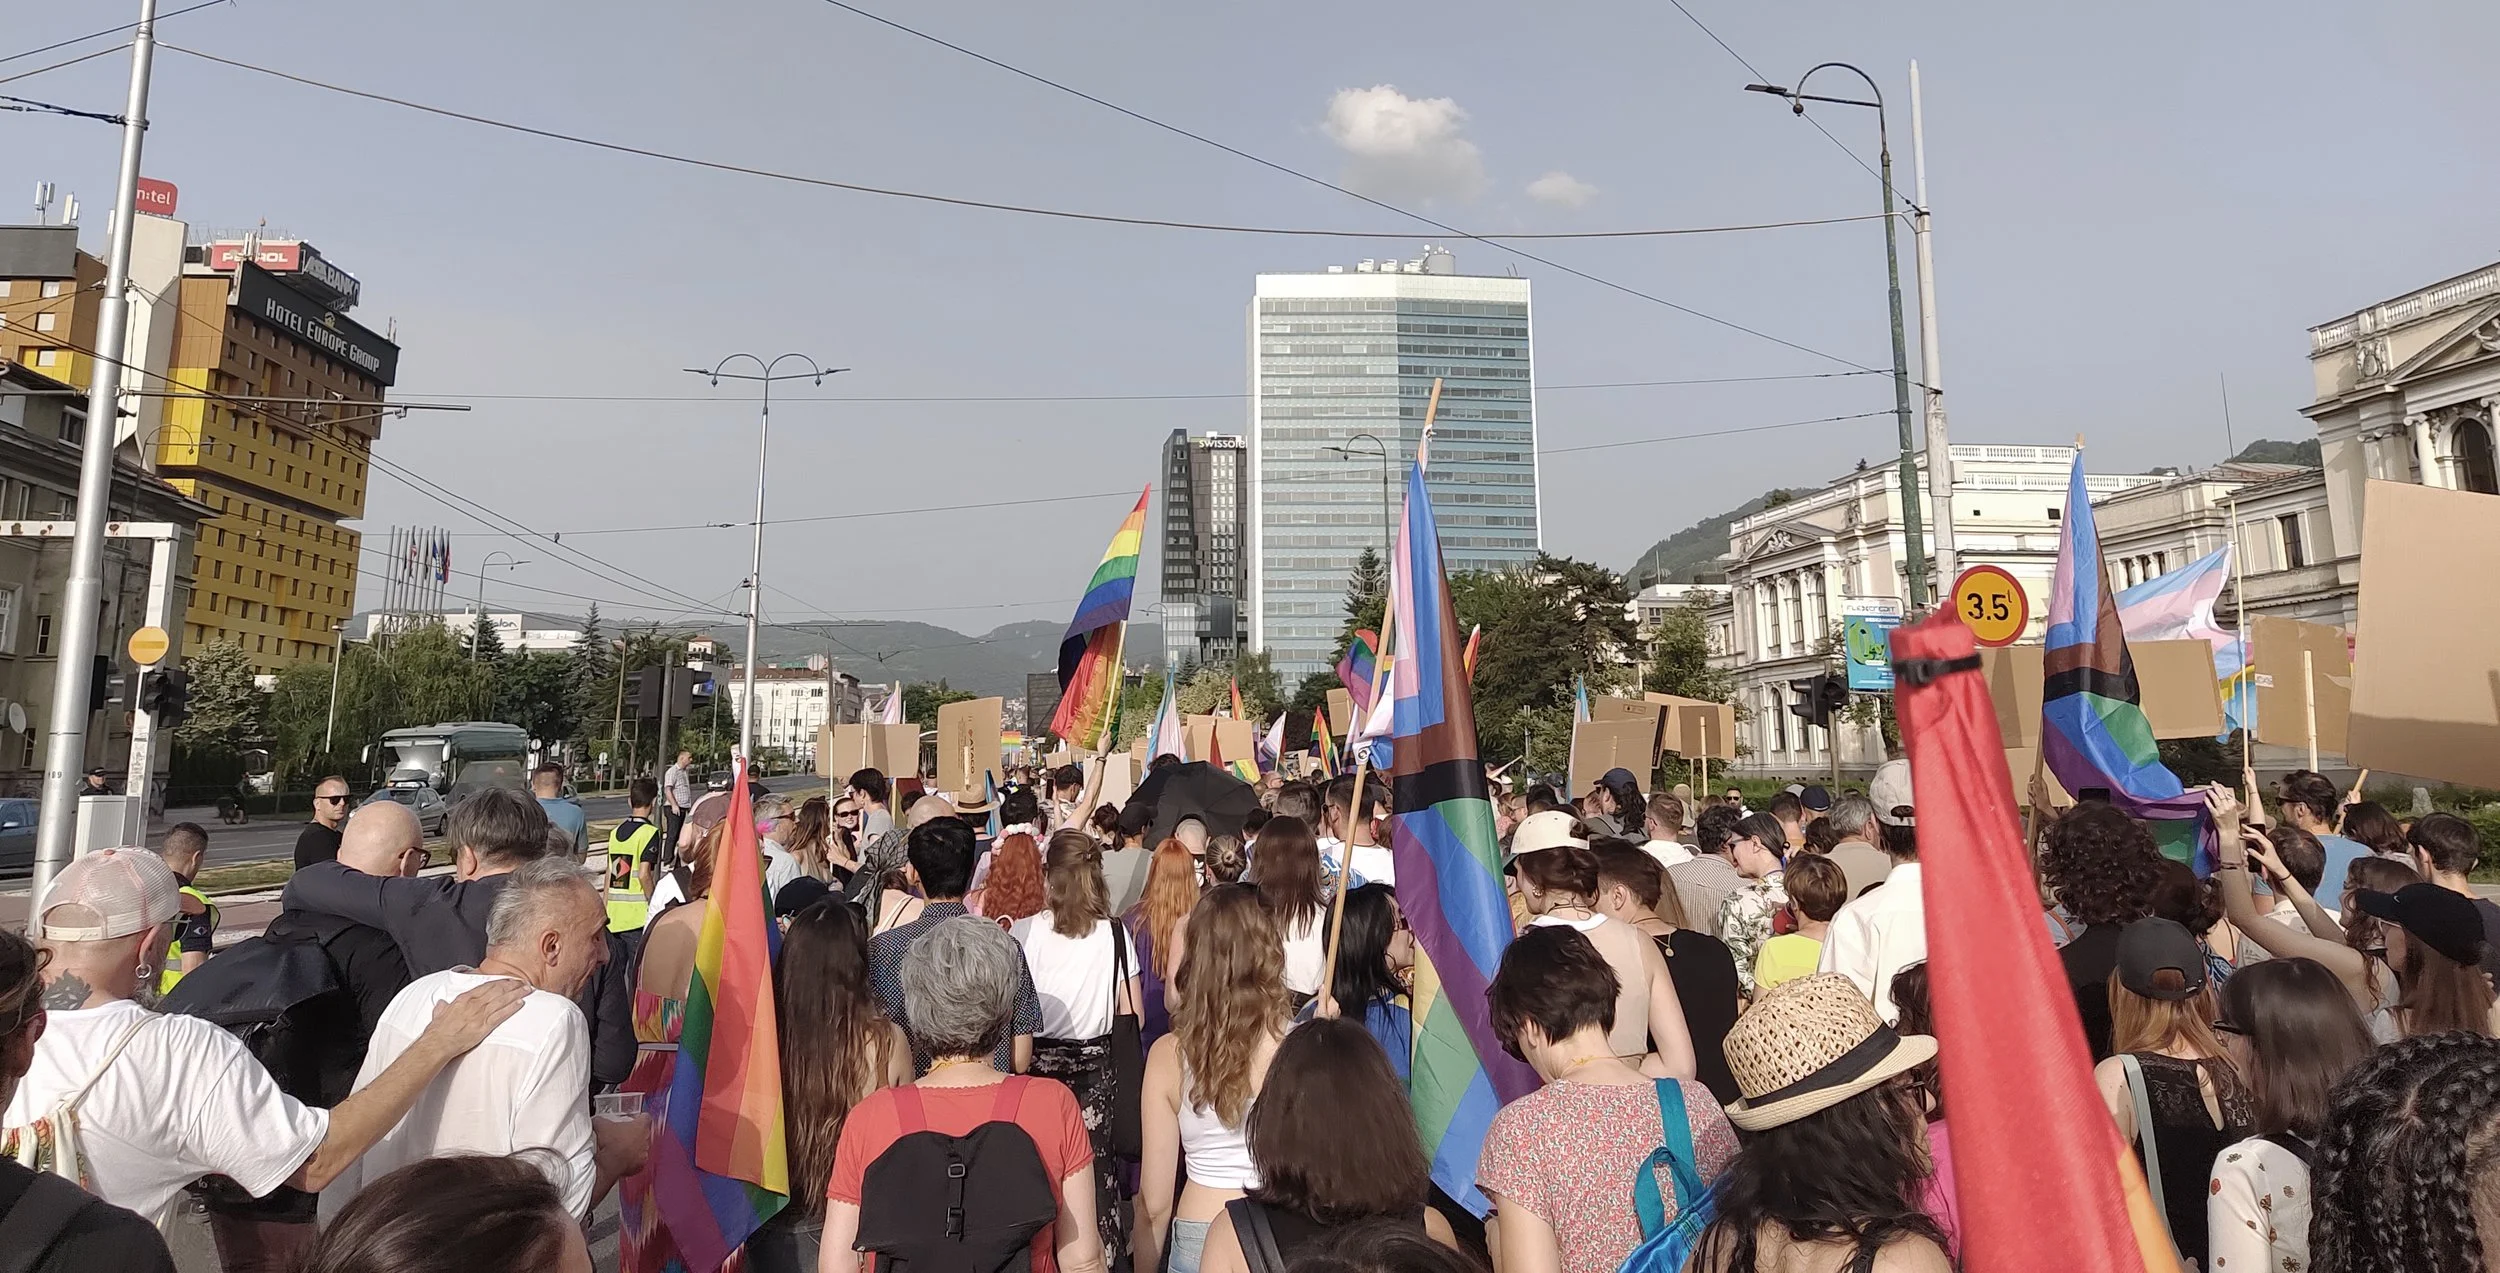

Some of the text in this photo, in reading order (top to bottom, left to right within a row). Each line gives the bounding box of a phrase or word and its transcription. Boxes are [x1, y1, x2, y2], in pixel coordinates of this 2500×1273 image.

[266, 297, 380, 373] HOTEL EUROPE GROUP
